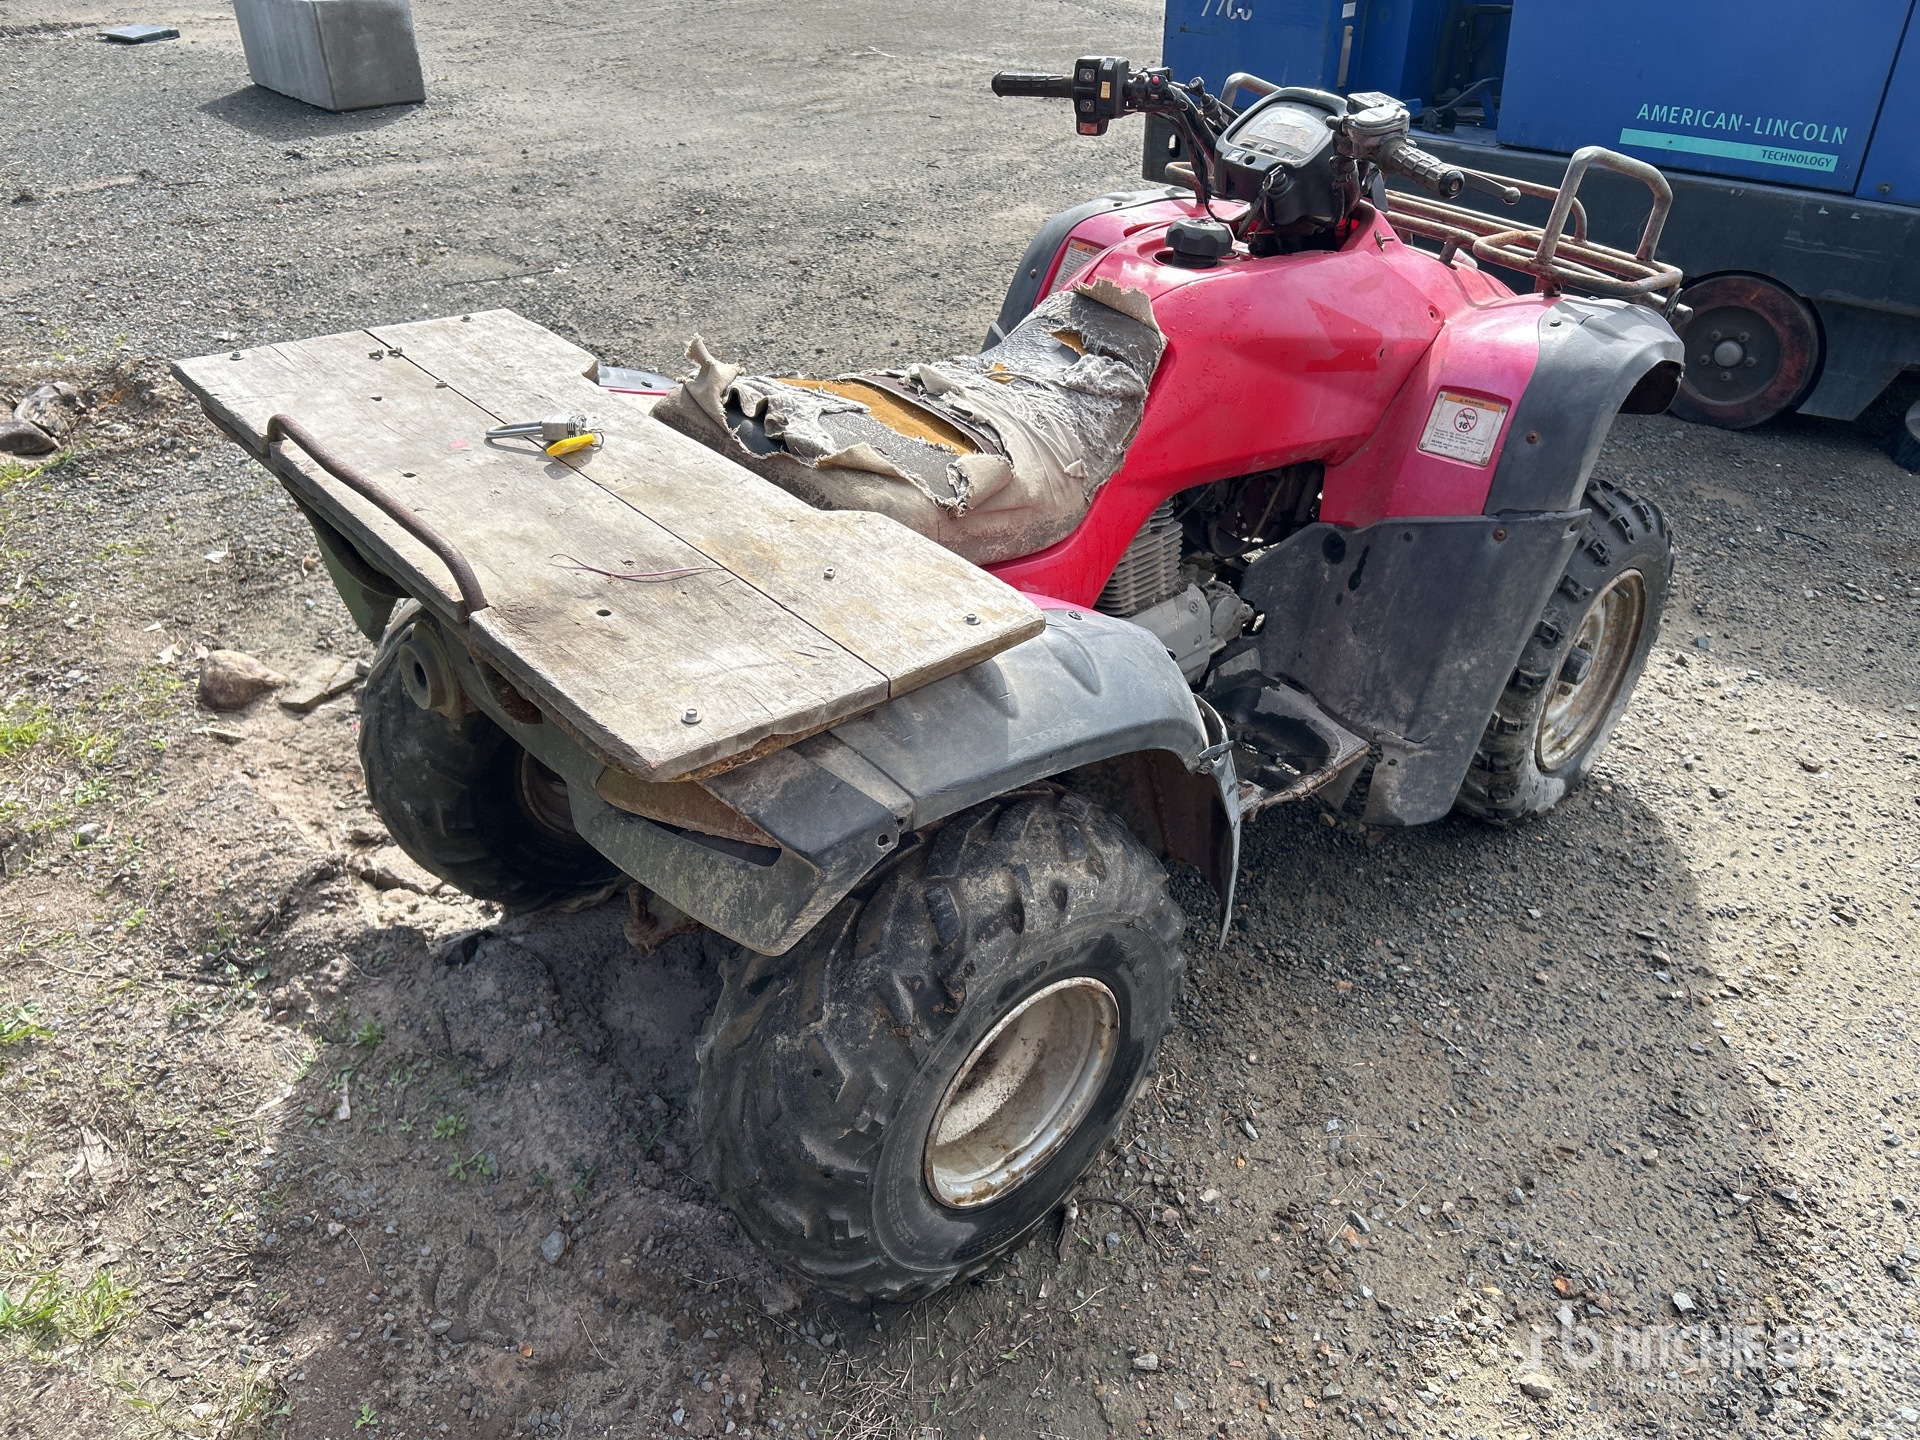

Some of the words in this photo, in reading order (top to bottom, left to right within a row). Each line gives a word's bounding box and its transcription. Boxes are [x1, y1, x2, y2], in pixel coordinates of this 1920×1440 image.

[1636, 103, 1848, 145] AMERICAN-LINCOLN
[1761, 149, 1833, 168] TECHNOLOGY
[1458, 421, 1468, 430] 16
